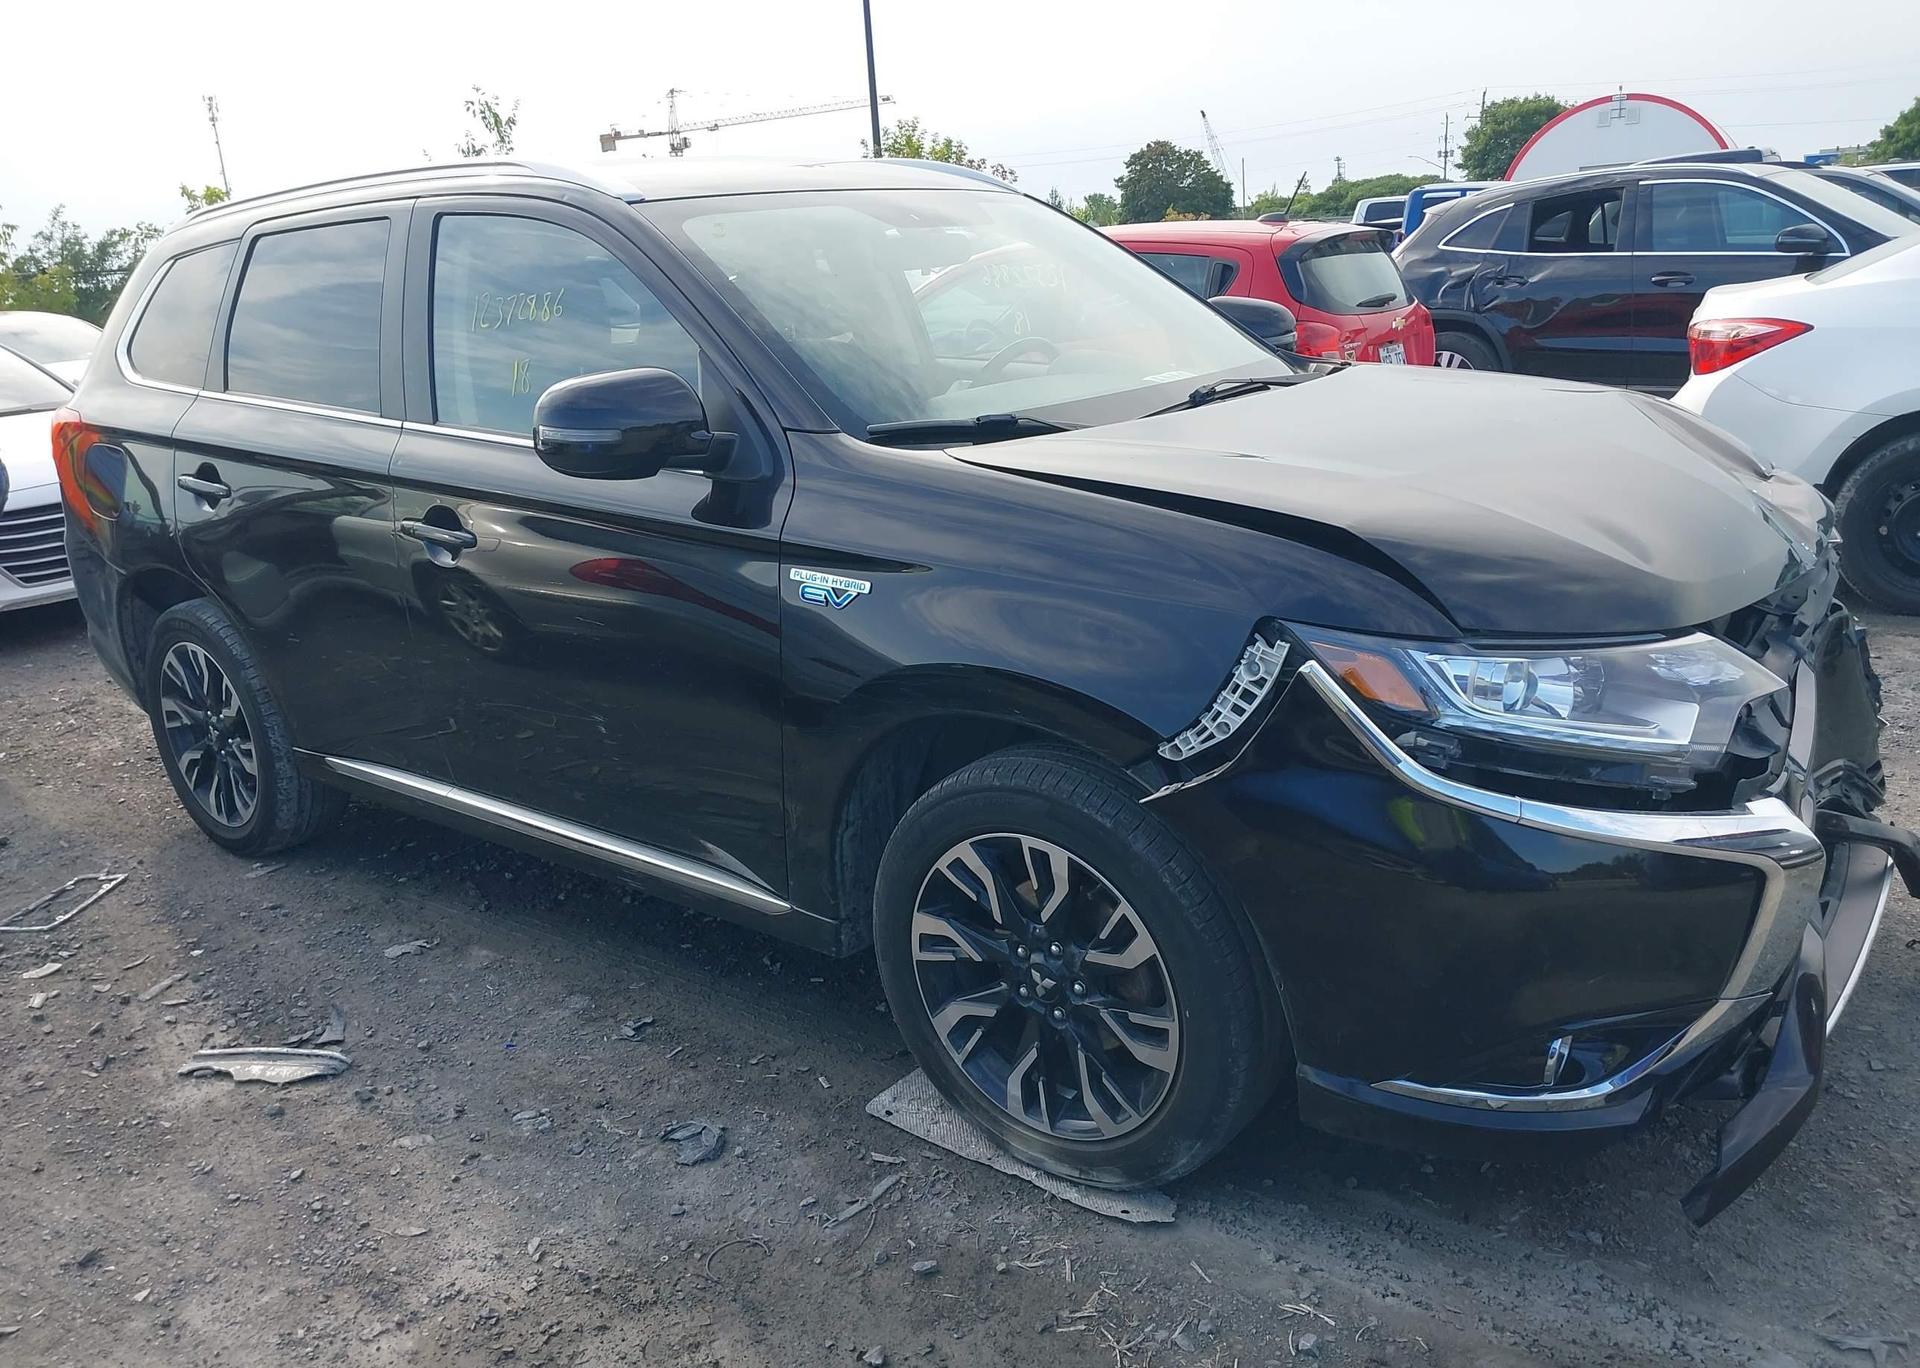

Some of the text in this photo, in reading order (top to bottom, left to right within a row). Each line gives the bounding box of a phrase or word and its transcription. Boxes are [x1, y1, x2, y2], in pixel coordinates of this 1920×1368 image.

[472, 288, 564, 332] 12372886
[512, 358, 530, 397] 18
[793, 570, 866, 591] PLUG-IN HYBRID
[799, 582, 858, 609] EV
